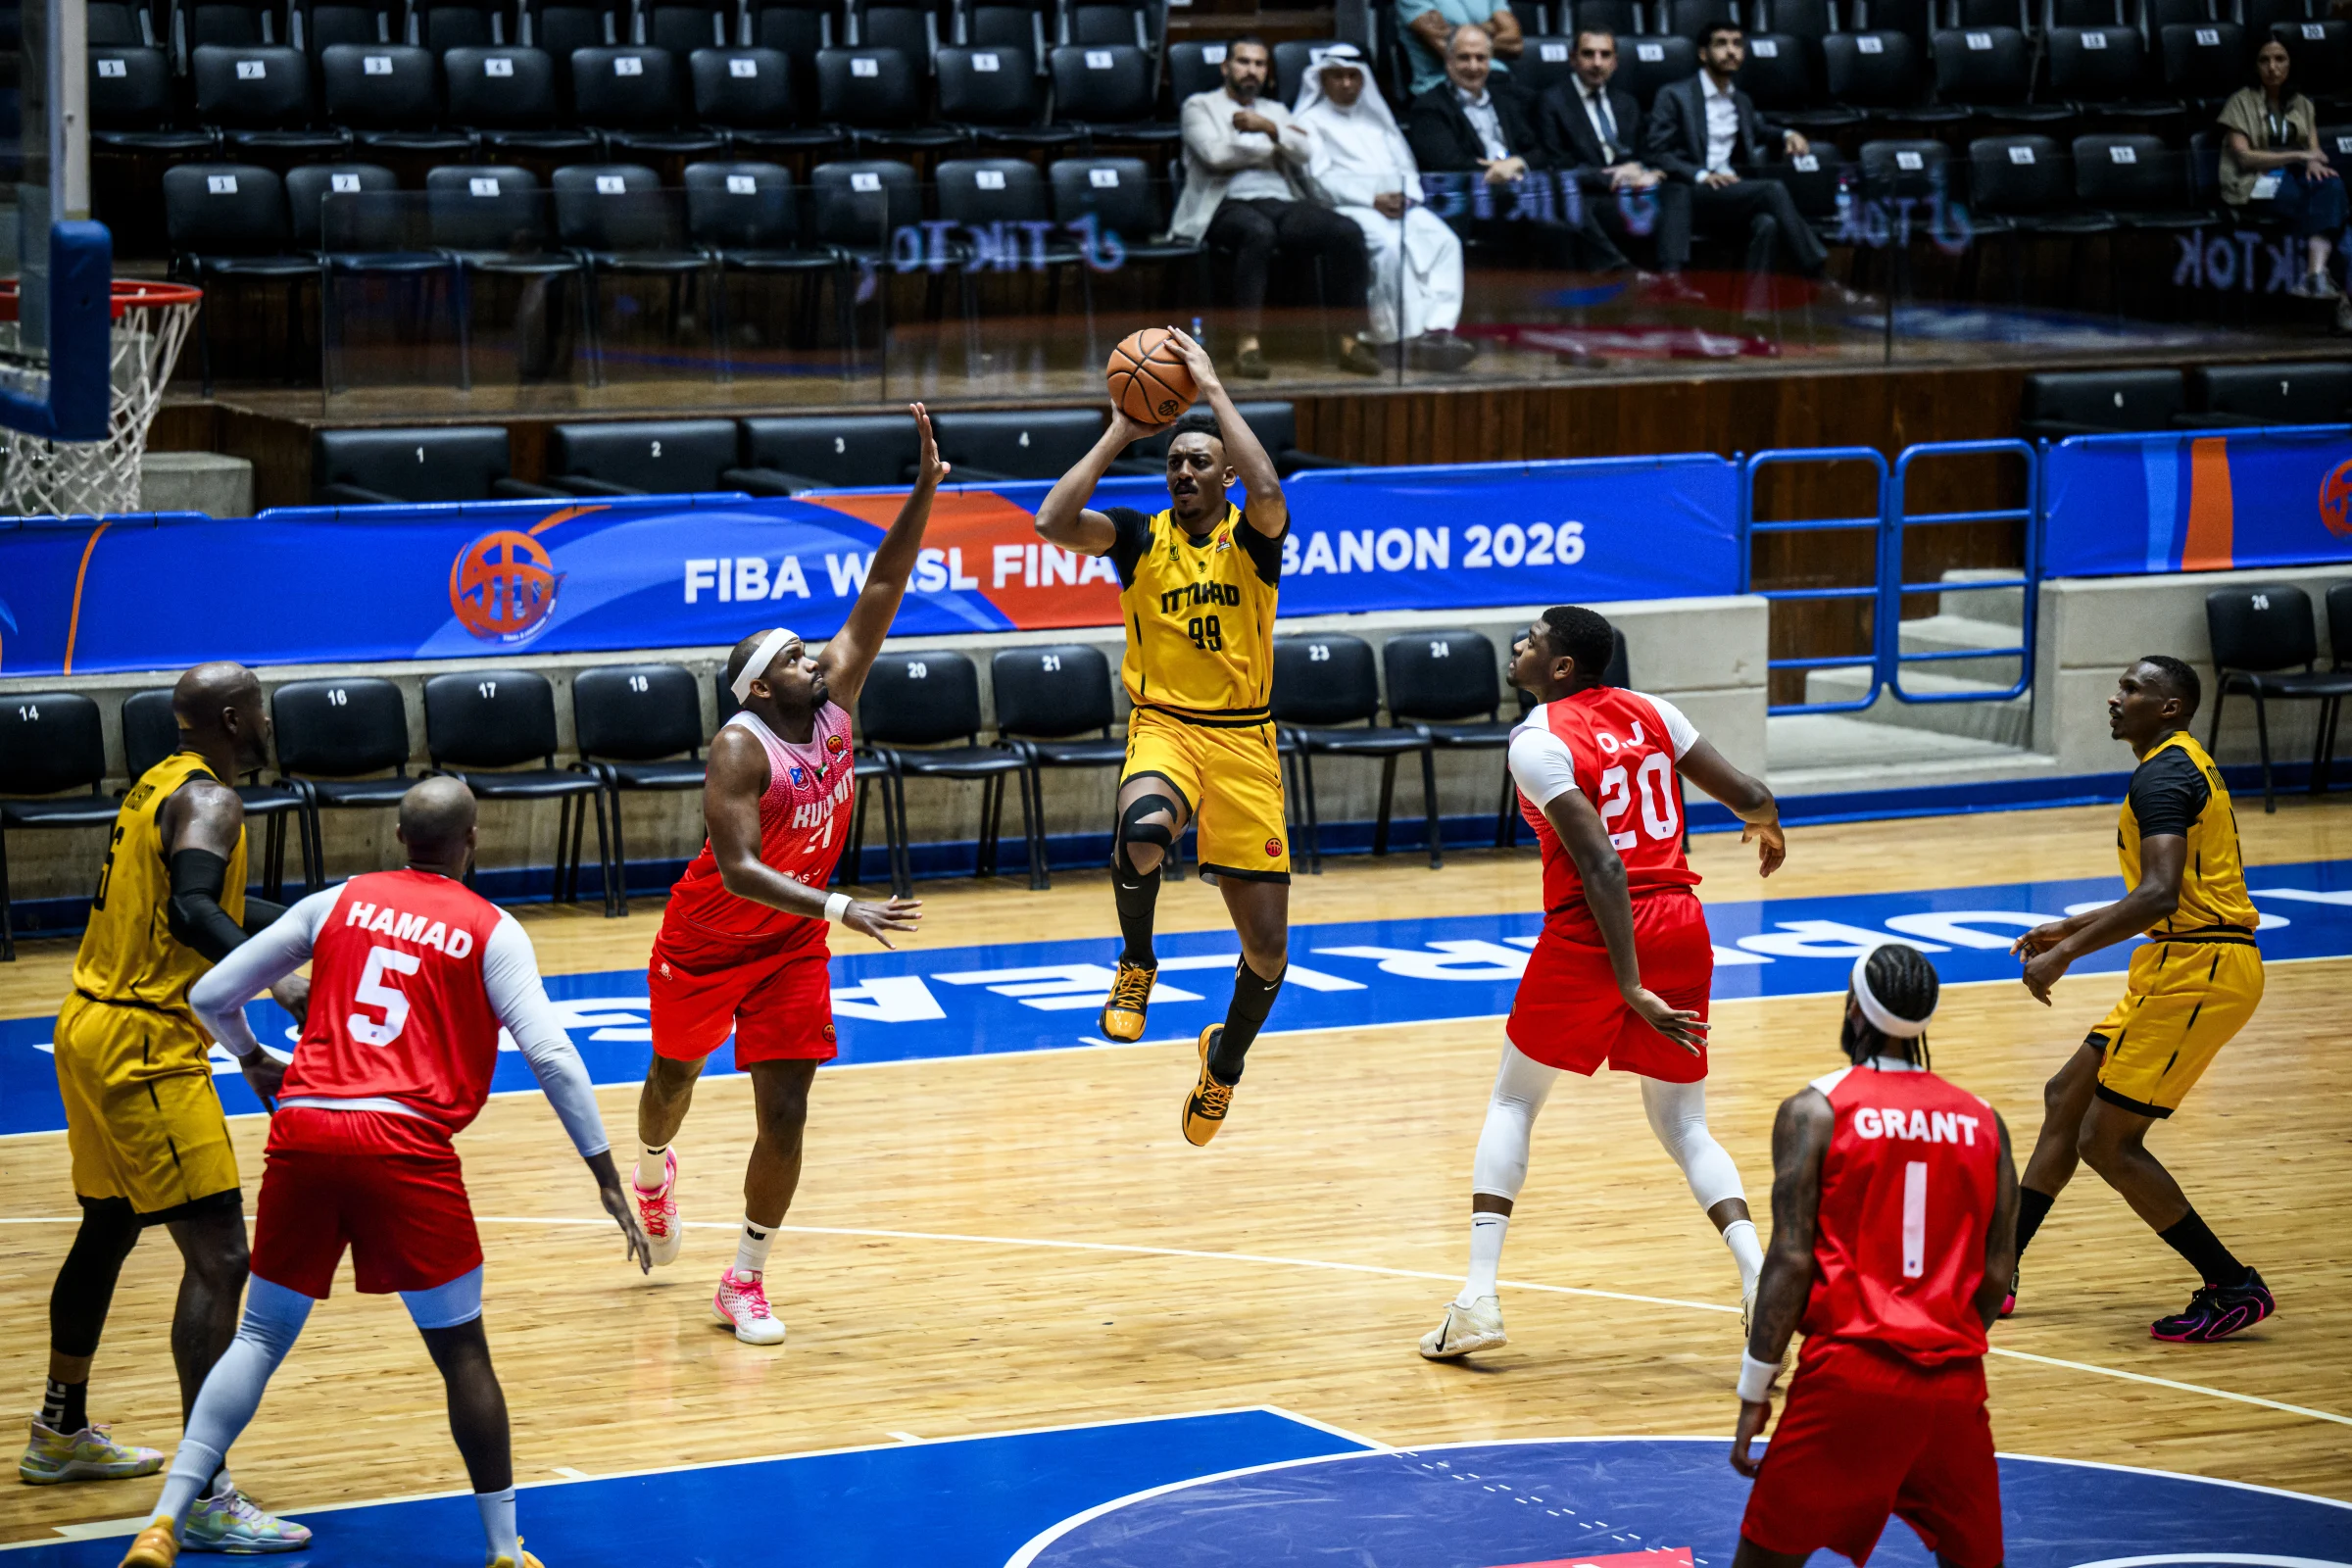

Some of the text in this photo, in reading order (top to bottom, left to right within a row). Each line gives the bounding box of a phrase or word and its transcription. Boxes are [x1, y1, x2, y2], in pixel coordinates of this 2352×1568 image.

[835, 437, 846, 454] 3
[1018, 431, 1030, 447] 4
[416, 447, 424, 463] 1
[651, 440, 662, 458] 2
[685, 555, 811, 604] FIBA
[825, 547, 978, 597] WSL
[993, 543, 1118, 589] FINA
[1463, 520, 1586, 568] 2026
[1188, 614, 1222, 653] 99
[1308, 644, 1330, 662] 23
[1430, 641, 1449, 658] 24
[907, 662, 927, 679] 20
[1042, 654, 1061, 671] 21
[478, 681, 496, 699] 17
[629, 674, 649, 692] 18
[327, 688, 348, 706] 16
[19, 705, 39, 721] 14
[1599, 751, 1678, 851] 20
[345, 901, 474, 959] HAMAD
[346, 945, 421, 1048] 5
[1854, 1107, 1980, 1147] GRANT
[1902, 1160, 1928, 1279] 1
